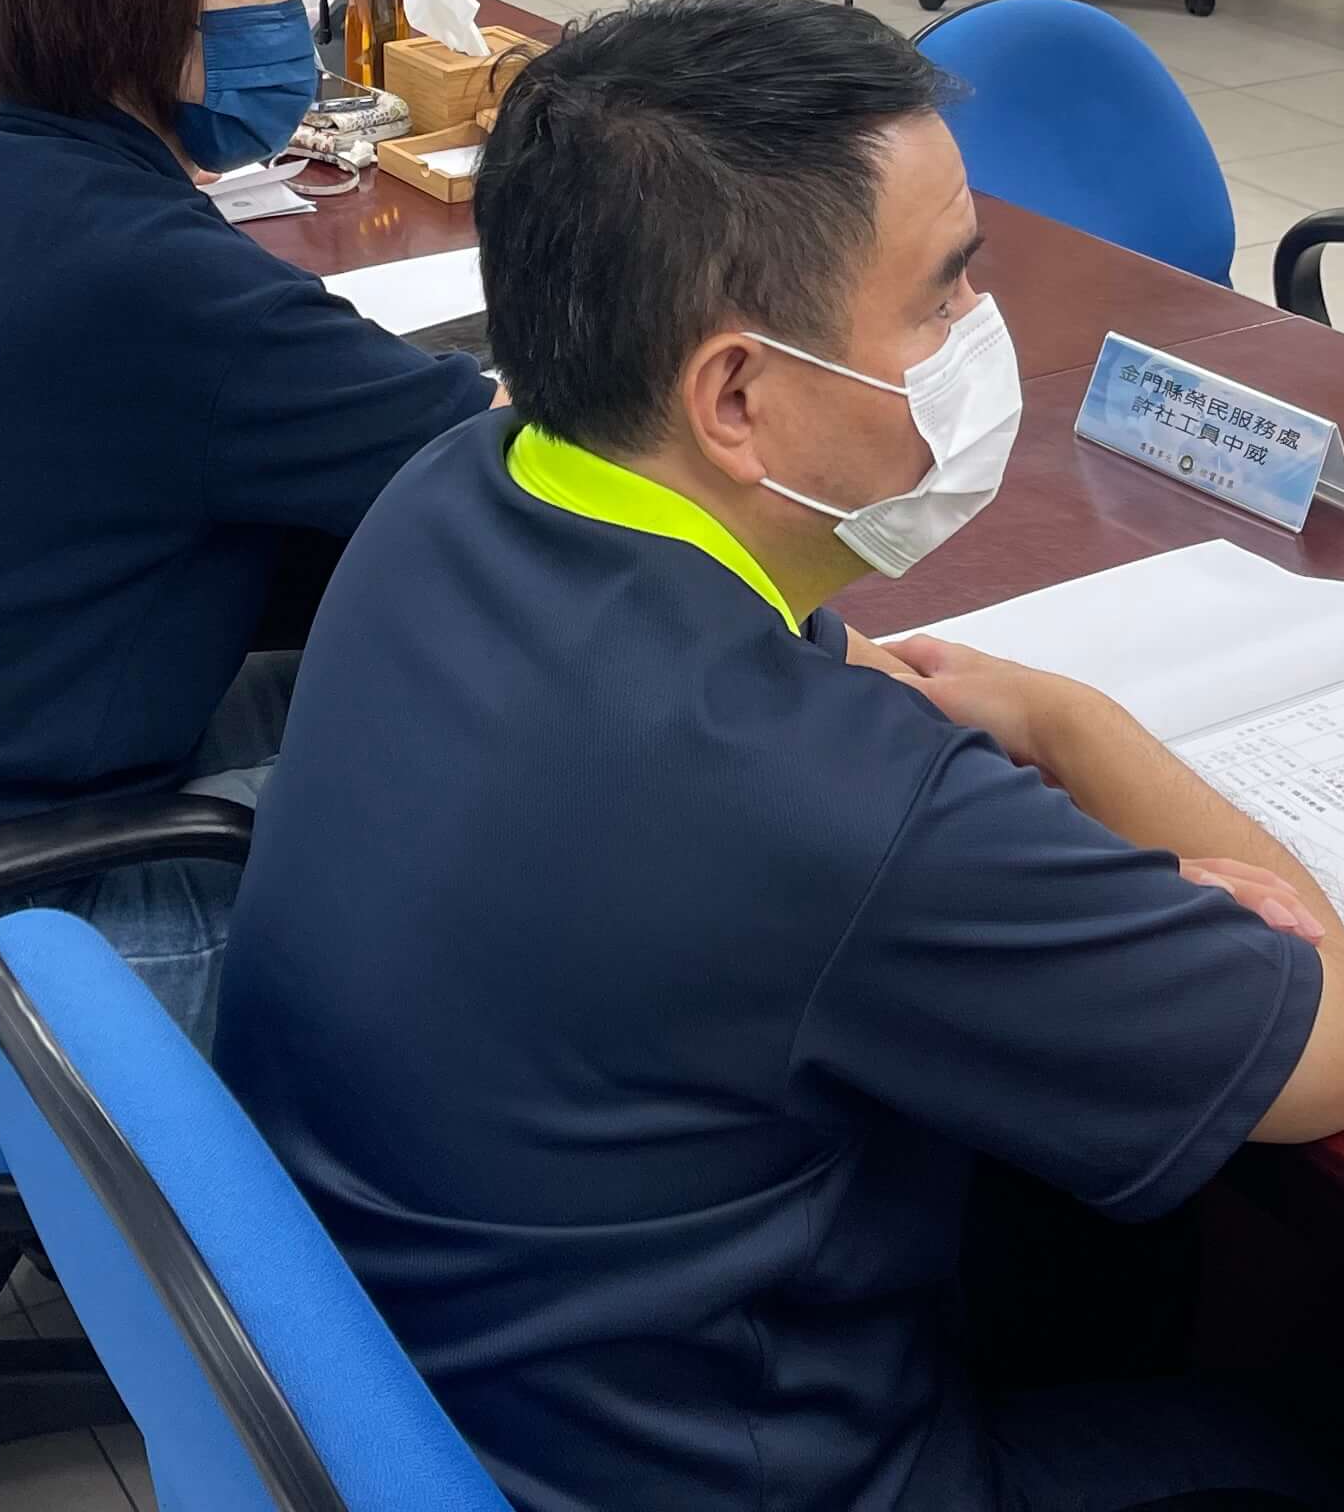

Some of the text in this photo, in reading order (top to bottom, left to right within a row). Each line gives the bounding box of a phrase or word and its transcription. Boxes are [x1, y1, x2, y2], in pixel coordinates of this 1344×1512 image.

[1119, 364, 1302, 451] 金門縣榮民服務處
[1131, 396, 1270, 467] 許社工員中威
